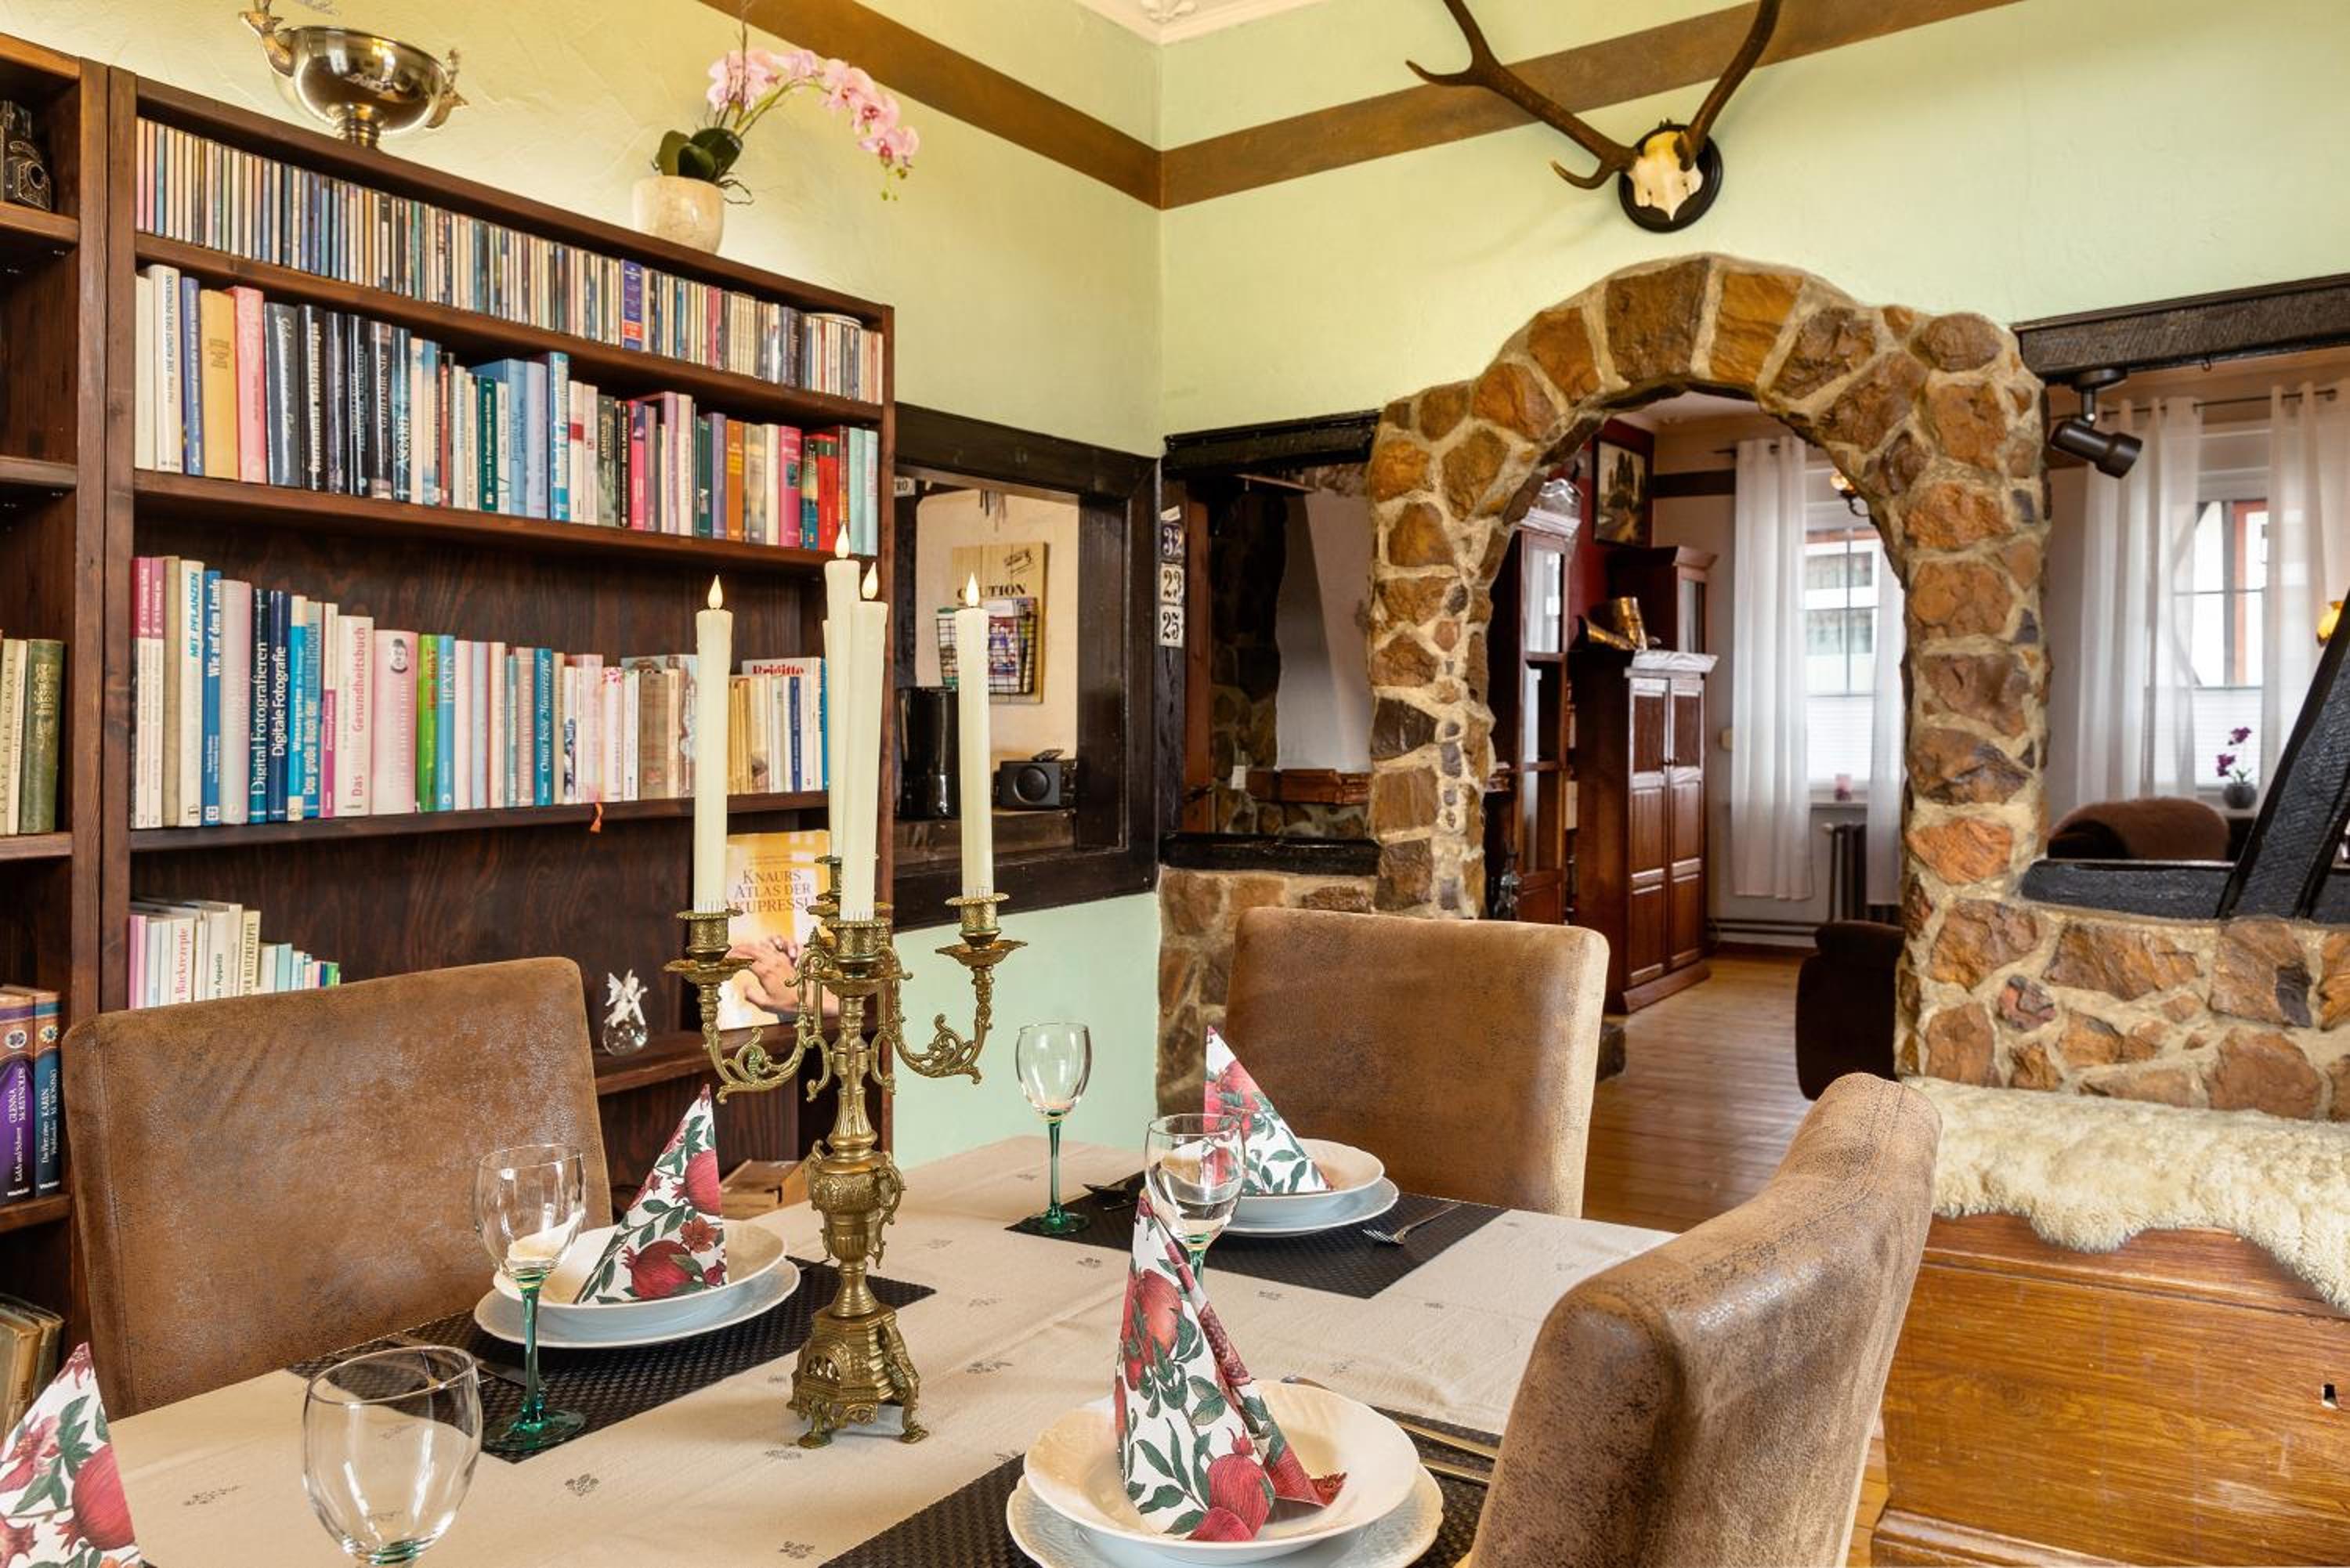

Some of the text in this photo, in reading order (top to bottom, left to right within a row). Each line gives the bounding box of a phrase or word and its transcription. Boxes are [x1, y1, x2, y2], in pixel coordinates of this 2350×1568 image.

[164, 275, 174, 314] PENDELNS
[165, 316, 174, 331] DES
[165, 331, 174, 358] KUNST
[165, 358, 174, 374] DIE
[396, 416, 410, 472] ASGARD
[956, 583, 1025, 601] CUTION
[188, 572, 200, 658] MIT PFLANZEN
[208, 579, 221, 677] Wie auf dem Lande
[1162, 612, 1180, 640] 25
[441, 655, 454, 703] HEXEN
[272, 646, 287, 757] Digitale Fotografie
[304, 701, 316, 717] der
[351, 627, 366, 797] Das Gesundheitsbuch
[251, 641, 268, 795] Digital Fotografieren
[292, 688, 303, 752] Wassergarten
[303, 720, 316, 742] Buch
[539, 720, 550, 742] beste
[304, 746, 318, 774] große
[540, 743, 550, 772] Omas
[303, 776, 316, 795] Das
[734, 883, 812, 899] ATLAS DER
[743, 869, 802, 884] KNAURS
[175, 927, 190, 993] Backrezepte
[244, 923, 256, 977] BLITZREZEPTE
[214, 953, 223, 986] Appétit
[8, 1088, 17, 1123] GLENNA
